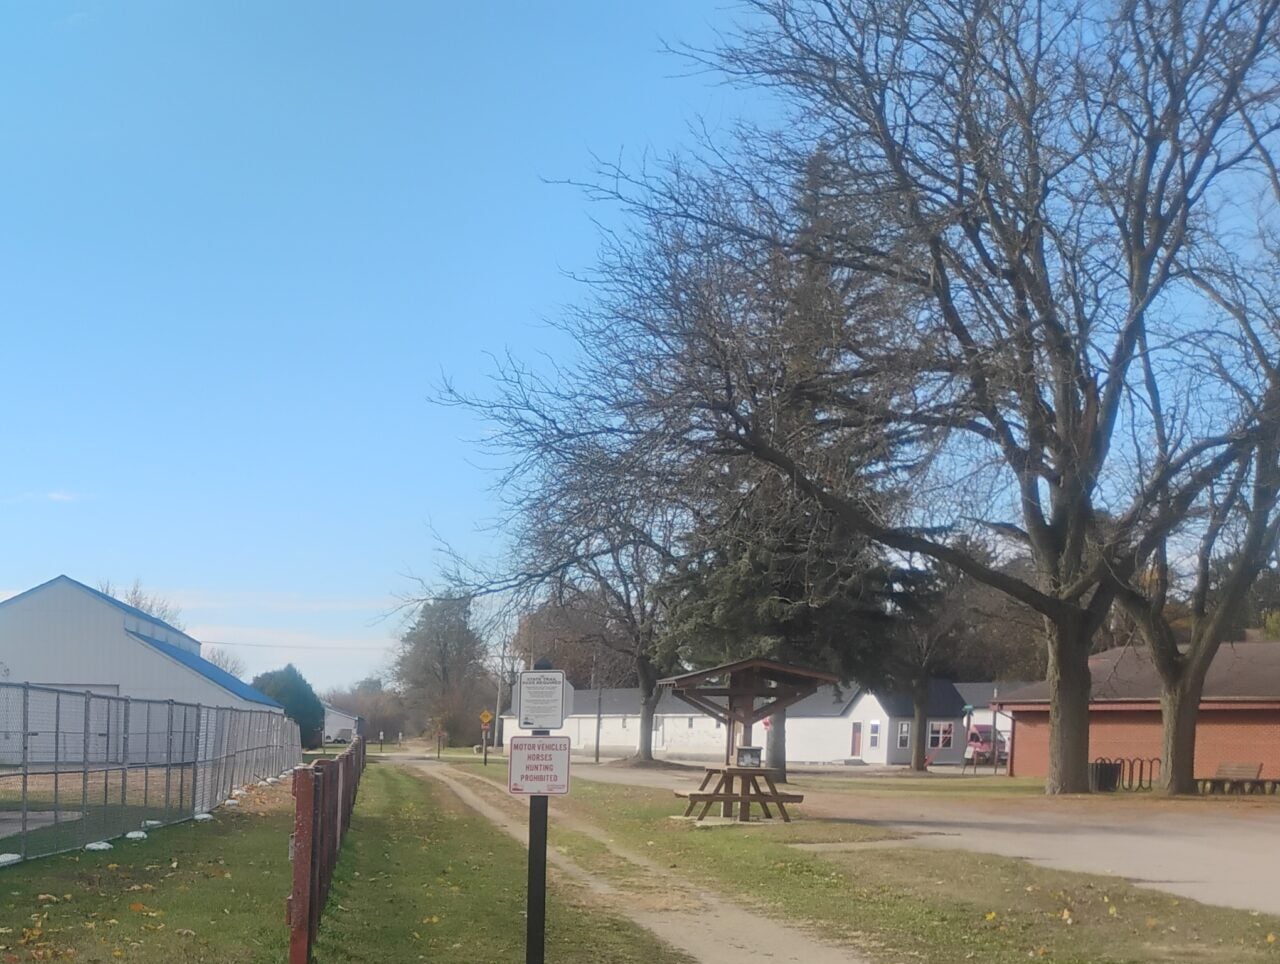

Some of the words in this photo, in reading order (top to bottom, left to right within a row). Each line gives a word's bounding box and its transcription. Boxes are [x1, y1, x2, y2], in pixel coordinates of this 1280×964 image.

[513, 743, 536, 751] MOTOR
[537, 743, 567, 751] VEHICLES
[525, 764, 554, 772] HUNTING
[520, 774, 558, 782] PROHIBITED
